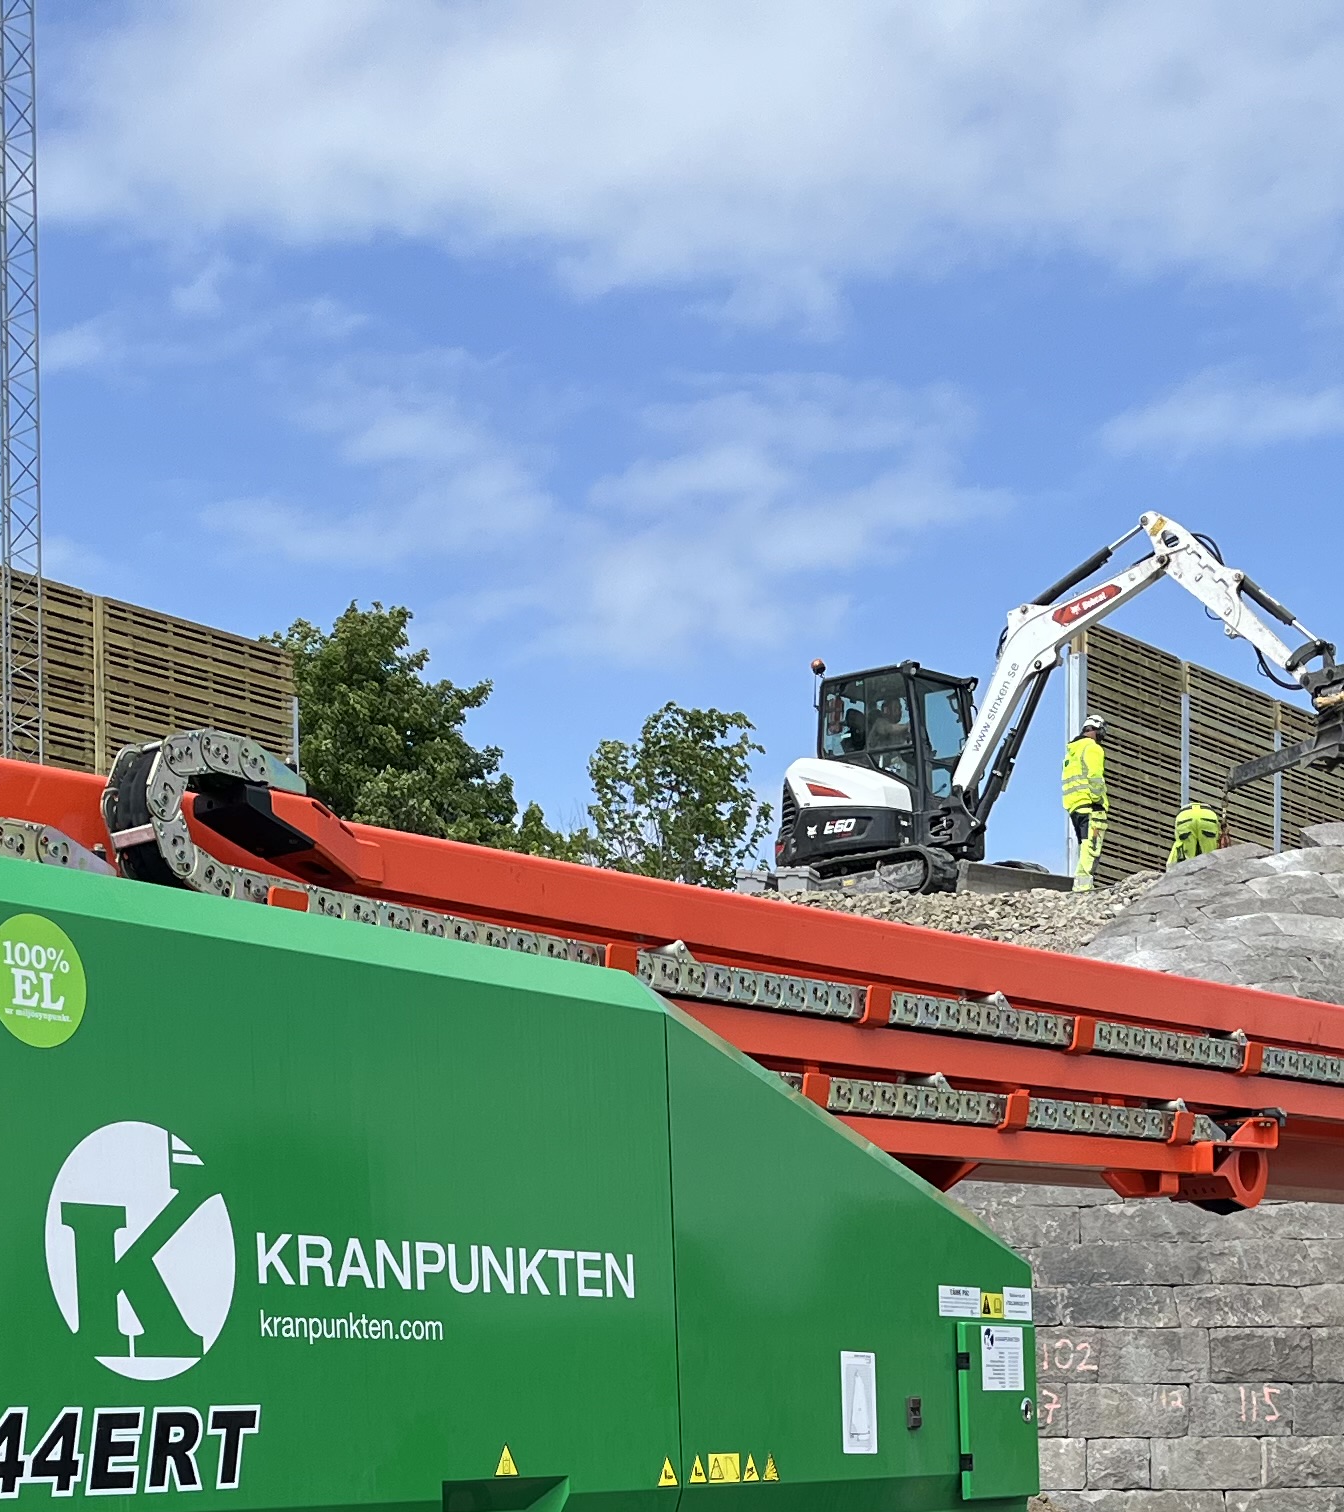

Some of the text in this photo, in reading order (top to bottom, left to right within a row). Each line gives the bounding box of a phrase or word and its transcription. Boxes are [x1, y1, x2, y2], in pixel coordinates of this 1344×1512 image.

[2, 940, 70, 974] 100%
[11, 967, 66, 1012] EL
[256, 1231, 636, 1300] KRANPUNKTEN
[259, 1309, 444, 1345] kranpunkten.com
[1042, 1338, 1099, 1372] 102
[1238, 1385, 1281, 1422] 115
